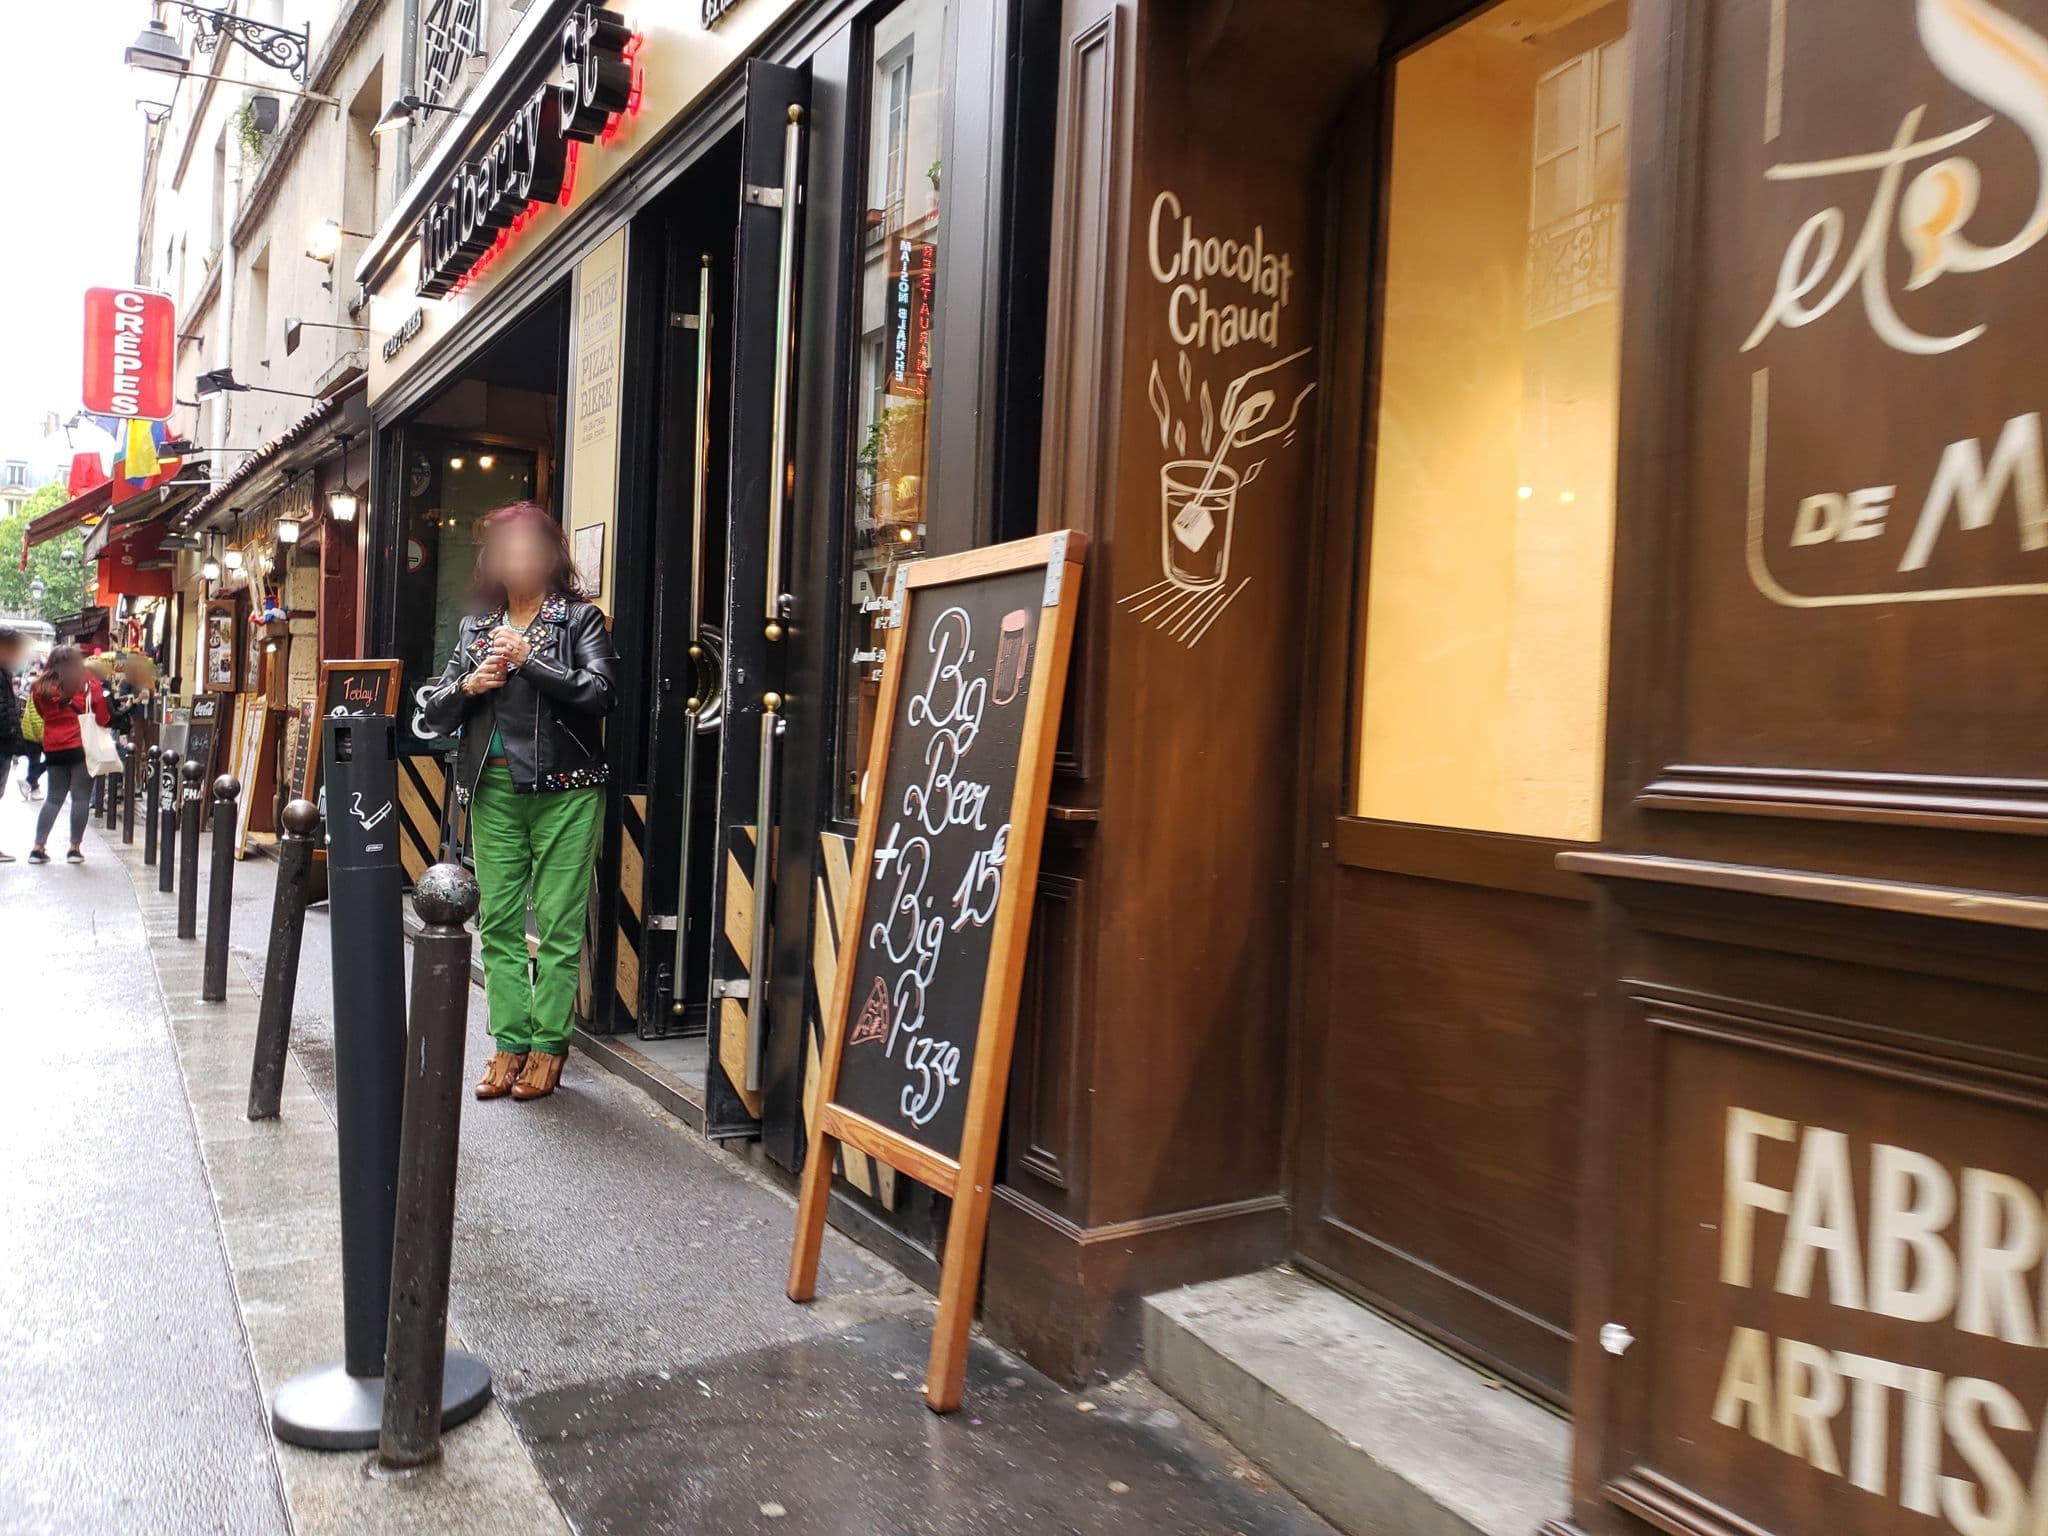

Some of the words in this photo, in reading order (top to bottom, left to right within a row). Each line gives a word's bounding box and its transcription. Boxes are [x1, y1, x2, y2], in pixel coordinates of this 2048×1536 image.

[559, 3, 602, 140] St
[1148, 190, 1293, 307] Chocolat
[581, 341, 615, 385] PIZZA
[1169, 283, 1279, 354] Chaud
[1790, 485, 1897, 547] DE
[344, 676, 381, 707] Today!
[908, 606, 987, 755] Big
[903, 729, 991, 836] Beer
[870, 836, 944, 989] Big
[885, 968, 961, 1127] Pizza
[1719, 1106, 2048, 1349] FABR
[1711, 1325, 2048, 1536] ARTIS
